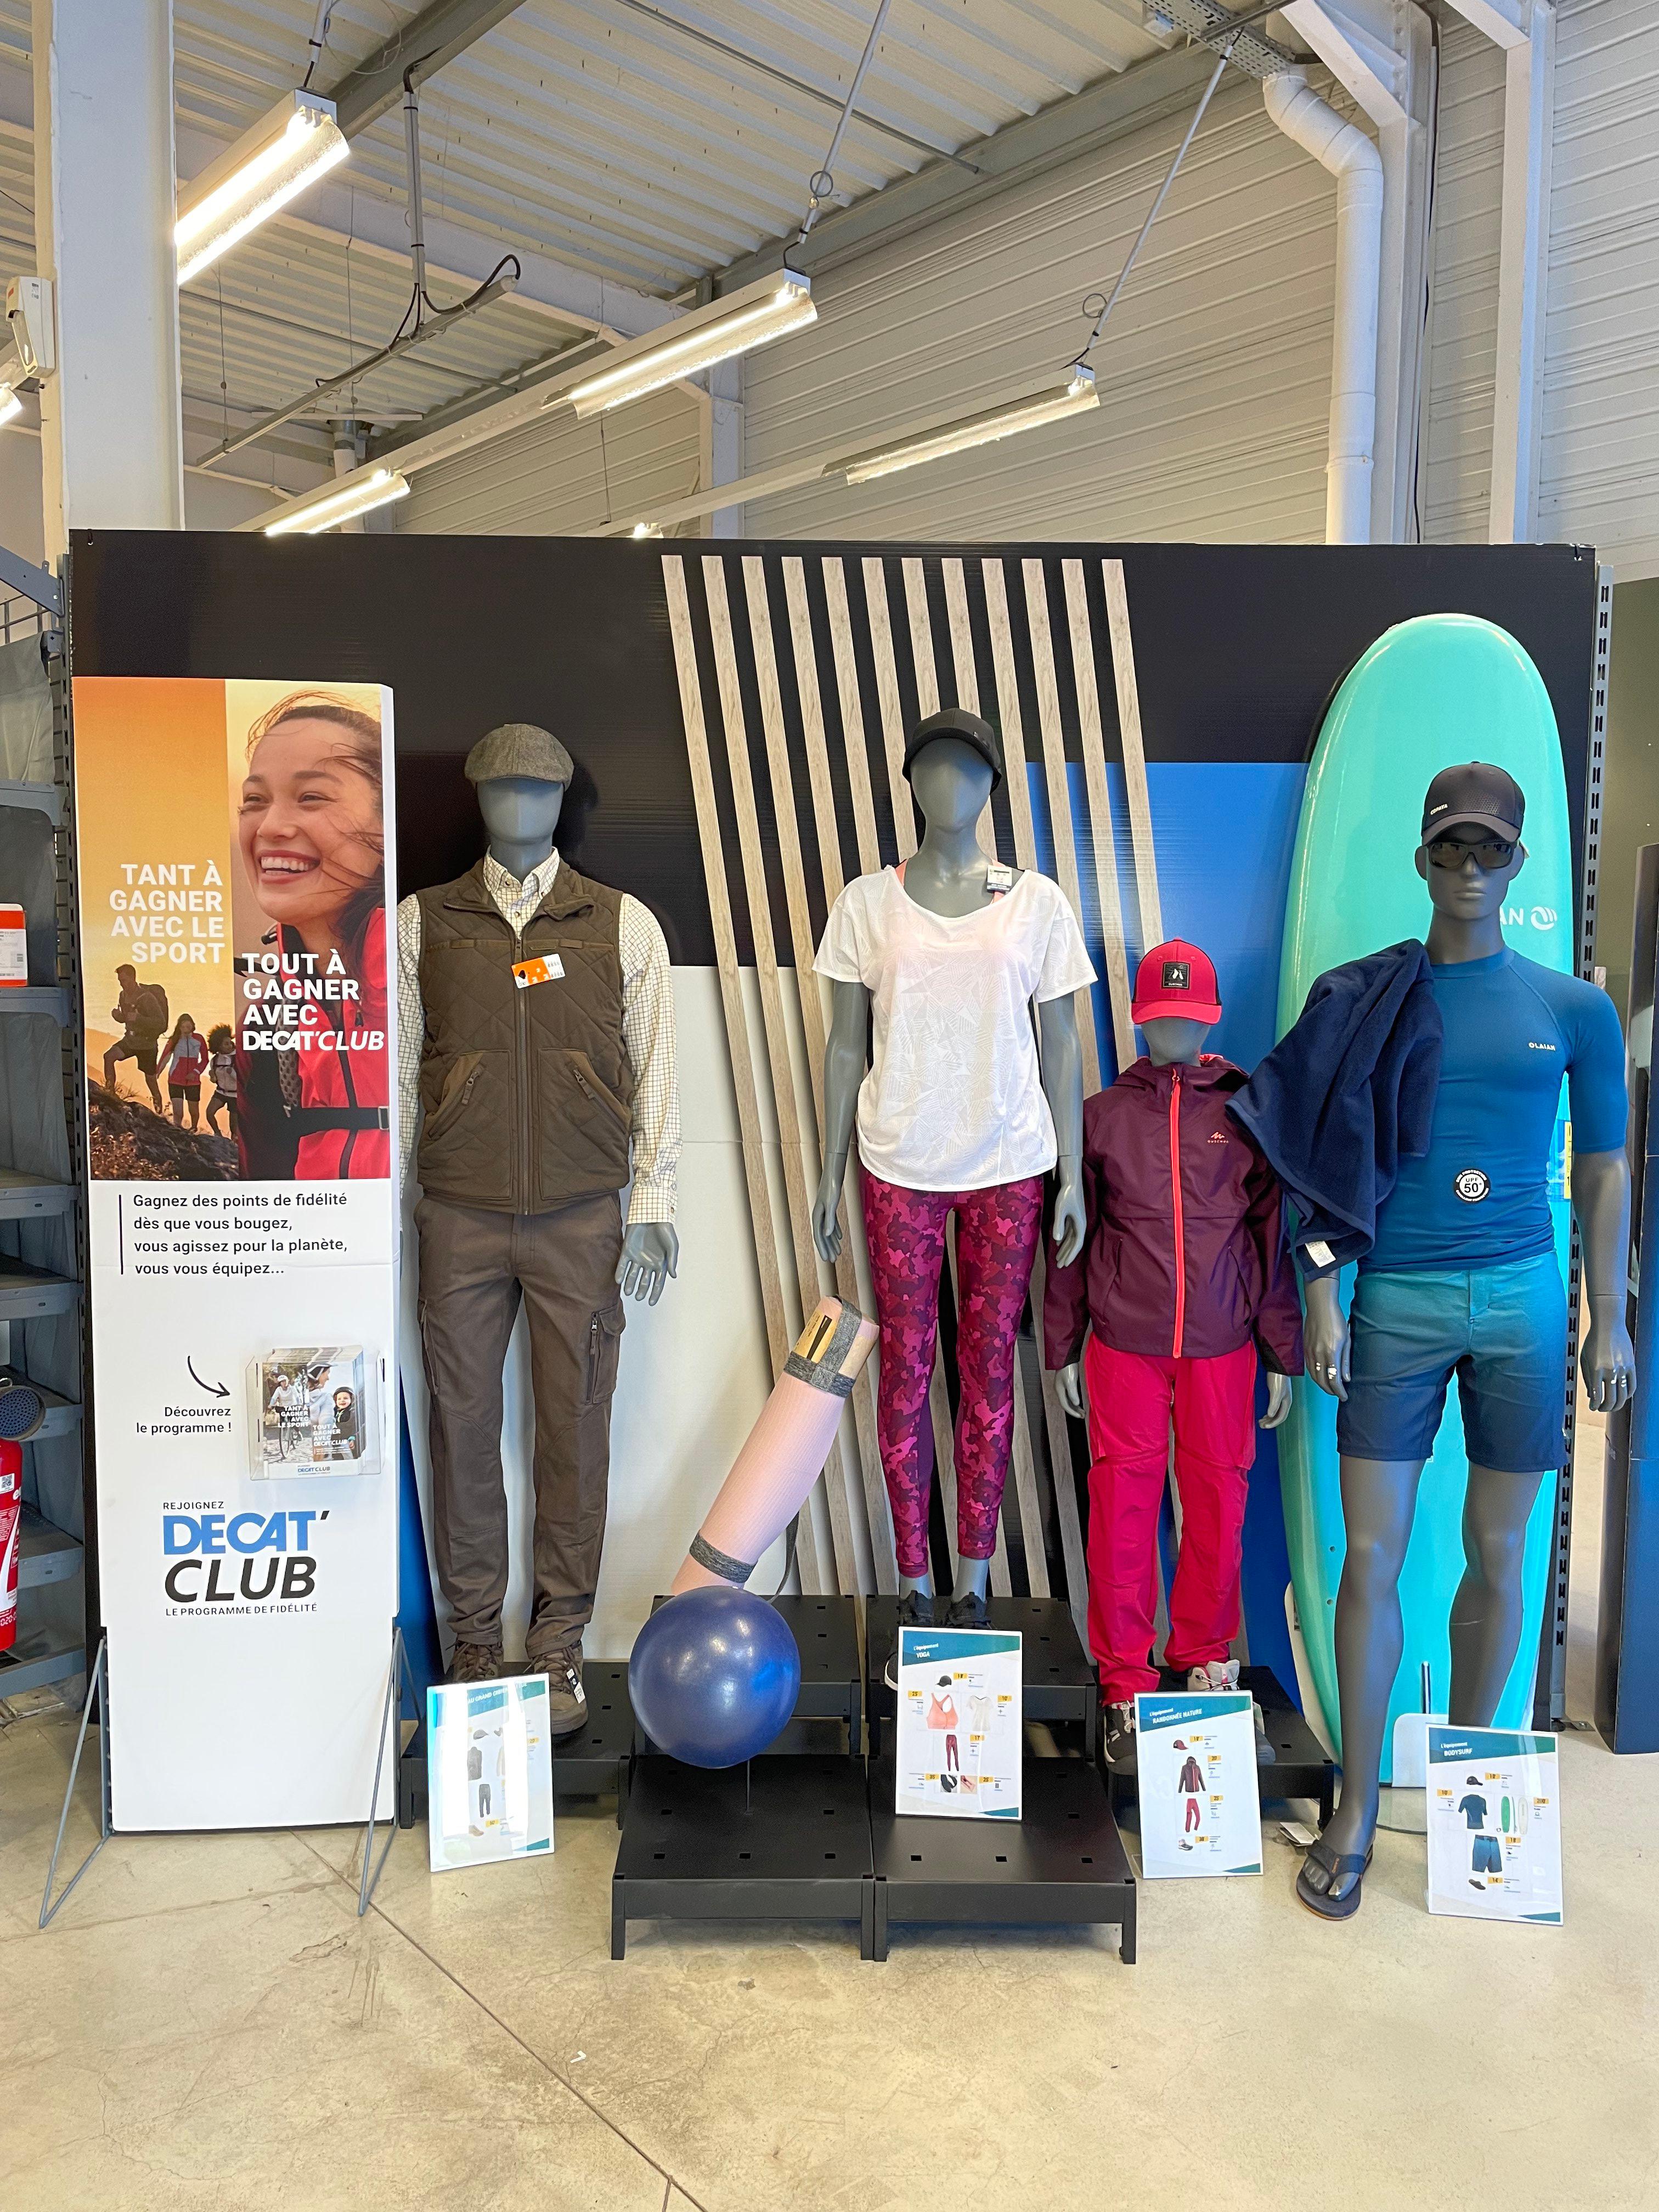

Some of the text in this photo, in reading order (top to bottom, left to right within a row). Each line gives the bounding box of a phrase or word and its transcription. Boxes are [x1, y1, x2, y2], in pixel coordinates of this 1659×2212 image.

[121, 859, 223, 886] TANT À
[109, 889, 223, 912] GAGNER
[110, 916, 224, 938] AVEC LE
[131, 941, 225, 963] SPORT
[241, 949, 347, 975] TOUT À
[242, 978, 360, 1001] GAGNER
[242, 1004, 318, 1025] AVEC
[1528, 1042, 1556, 1051] OLAIAN
[133, 1192, 347, 1210] Gagnez des points de fidélité
[134, 1216, 292, 1232] dès que vous bougez,
[134, 1238, 347, 1255] vous agissez pour la planète,
[135, 1262, 284, 1277] vous vous équipez...
[165, 1406, 232, 1417] Découvrez
[137, 1422, 147, 1433] le
[151, 1424, 224, 1436] programme
[163, 1501, 224, 1510] REJOIGNEZ
[163, 1510, 330, 1555] DECAT'
[165, 1556, 317, 1603] CLUB
[166, 1602, 317, 1616] LE PROGRAMME DE FIDÉLITÉ
[475, 1692, 492, 1702] GRAND
[1153, 1708, 1203, 1724] RANDONNÉE NATURE
